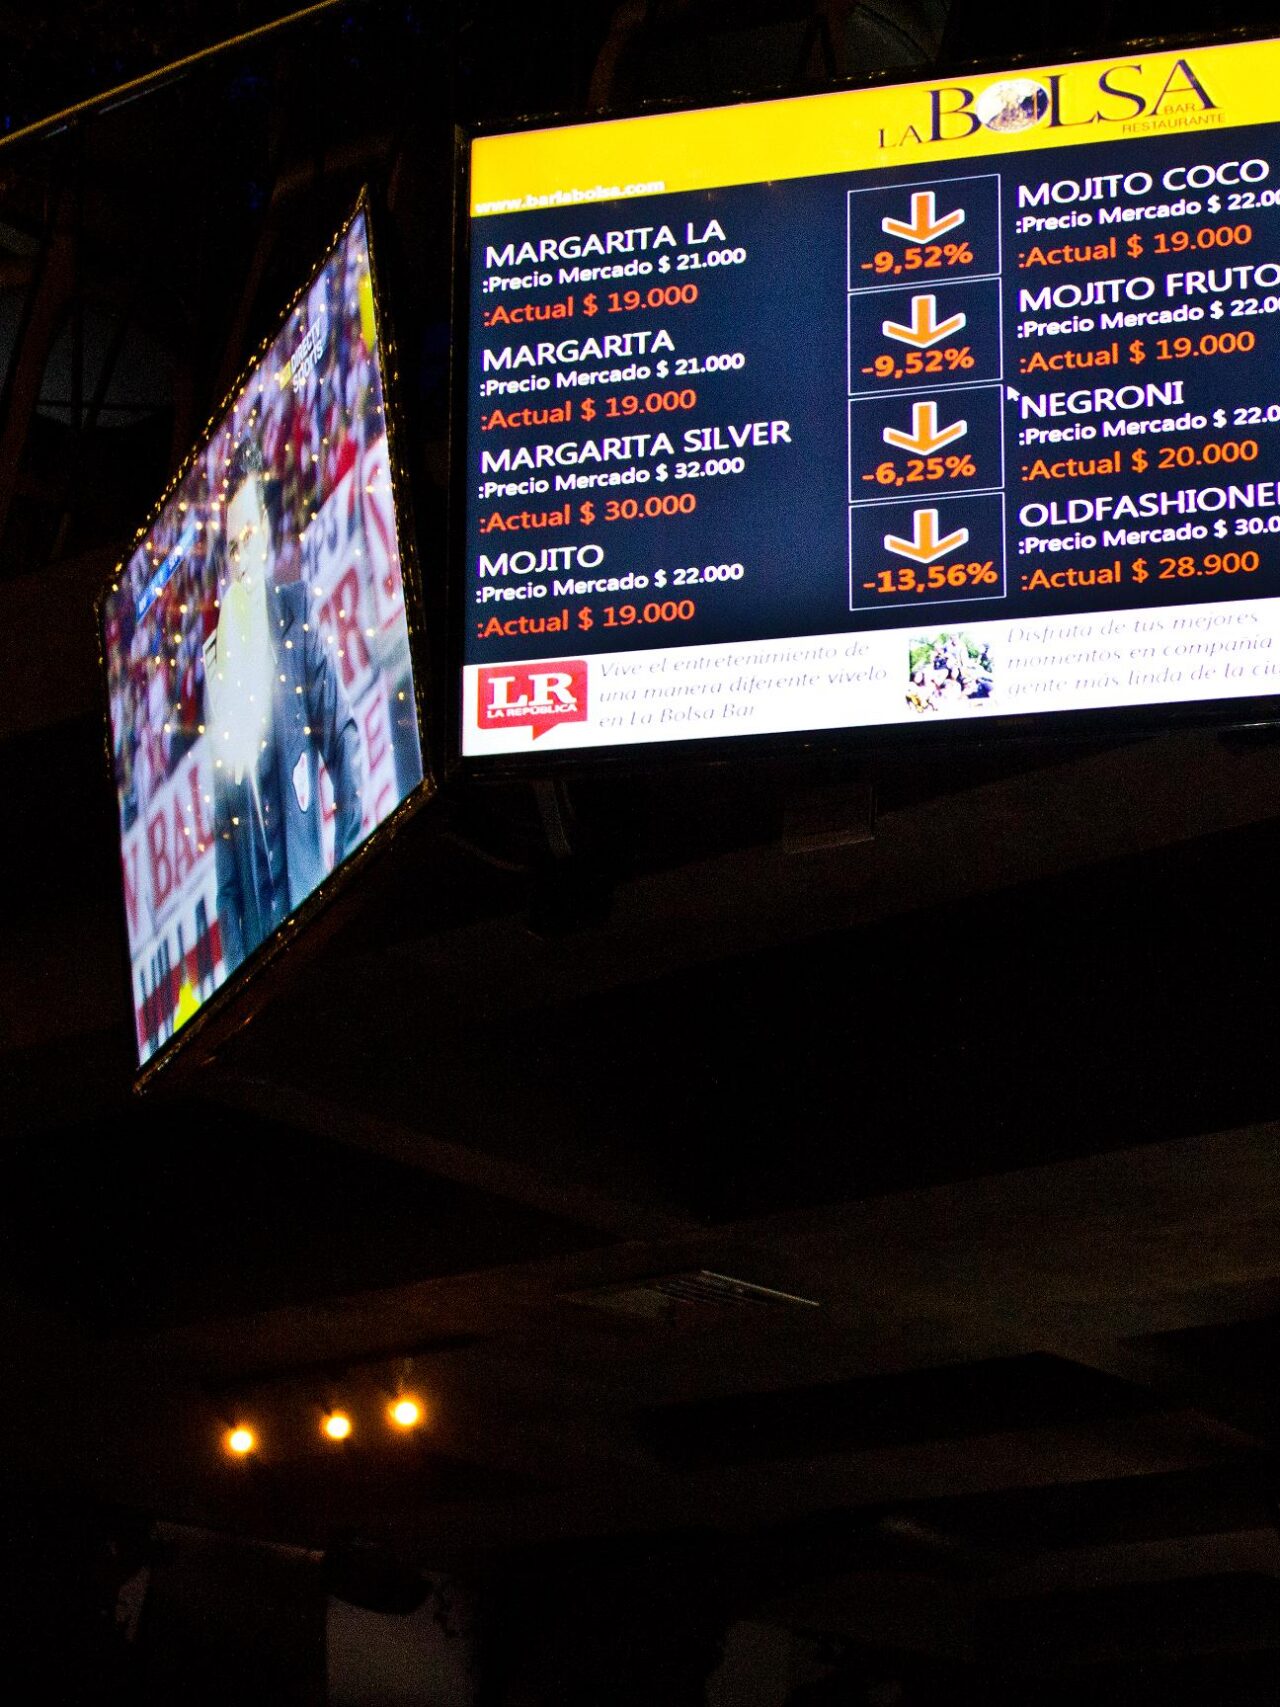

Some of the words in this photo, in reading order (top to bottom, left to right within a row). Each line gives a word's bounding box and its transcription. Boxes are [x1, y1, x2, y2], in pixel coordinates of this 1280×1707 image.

[879, 124, 922, 148] LA
[924, 57, 1223, 142] BOLSA
[1163, 102, 1198, 116] BAR
[1121, 112, 1226, 134] RESTAURANTE
[1019, 172, 1152, 207] MOJITO
[1163, 159, 1269, 190] COCO
[1016, 211, 1092, 233] :Precio
[1099, 199, 1201, 224] Mercado
[1208, 195, 1221, 213] $
[486, 226, 676, 268] MARGARITA
[687, 220, 726, 244] LA
[861, 242, 973, 274] -9,52%
[1019, 237, 1116, 268] :Actual
[1127, 234, 1143, 258] $
[1155, 225, 1252, 253] 19.000
[483, 271, 552, 293] :Precio
[559, 259, 653, 284] Mercado
[659, 255, 670, 273] $
[677, 248, 746, 270] 21.000
[484, 296, 573, 326] :Actual
[583, 293, 598, 316] $
[608, 284, 698, 312] 19.000
[1020, 277, 1155, 312] MOJITO
[1018, 316, 1094, 338] :Precio
[1101, 304, 1204, 329] Mercado
[1210, 301, 1224, 319] $
[484, 330, 675, 371] MARGARITA
[862, 347, 974, 378] -9,52%
[1020, 343, 1118, 373] :Actual
[1129, 340, 1145, 364] $
[1157, 331, 1255, 360] 19.000
[480, 375, 550, 396] :Precio
[557, 364, 651, 388] Mercado
[657, 360, 669, 378] $
[675, 353, 745, 375] 21.000
[482, 401, 571, 431] :Actual
[581, 398, 596, 421] $
[606, 389, 696, 417] 19.000
[1019, 381, 1184, 419] NEGRONI
[1019, 423, 1096, 445] :Precio
[1103, 413, 1207, 437] Mercado
[1213, 409, 1227, 428] $
[482, 433, 674, 473] MARGARITA
[684, 421, 791, 452] SILVER
[1022, 451, 1120, 481] :Actual
[1132, 448, 1148, 473] $
[1158, 440, 1258, 468] 20.000
[479, 477, 549, 499] :Precio
[556, 467, 650, 491] Mercado
[656, 463, 668, 482] $
[675, 457, 745, 479] 32.000
[862, 455, 976, 486] -6,25%
[480, 504, 570, 533] :Actual
[580, 501, 595, 525] $
[605, 493, 696, 521] 30.000
[1019, 532, 1096, 554] :Precio
[1103, 523, 1208, 547] Mercado
[1214, 519, 1227, 538] $
[479, 545, 604, 577] MOJITO
[863, 561, 998, 592] -13,56%
[1022, 561, 1120, 590] :Actual
[1132, 558, 1148, 583] $
[1159, 551, 1259, 579] 28.900
[476, 582, 547, 603] :Precio
[554, 573, 649, 596] Mercado
[654, 569, 667, 588] $
[673, 563, 744, 585] 22.000
[478, 609, 568, 638] :Actual
[578, 607, 593, 630] $
[604, 600, 695, 626] 19.000
[602, 664, 641, 676] Vive
[650, 658, 666, 672] el
[674, 648, 836, 670] entretenimiento
[845, 642, 868, 656] de
[487, 670, 577, 710] LR
[600, 691, 635, 702] una
[645, 683, 721, 698] manera
[730, 674, 819, 693] diferente
[486, 709, 504, 718] LA
[600, 718, 622, 727] en
[631, 712, 652, 725] La
[660, 707, 714, 722] Bolsa
[723, 704, 753, 717] Bar
